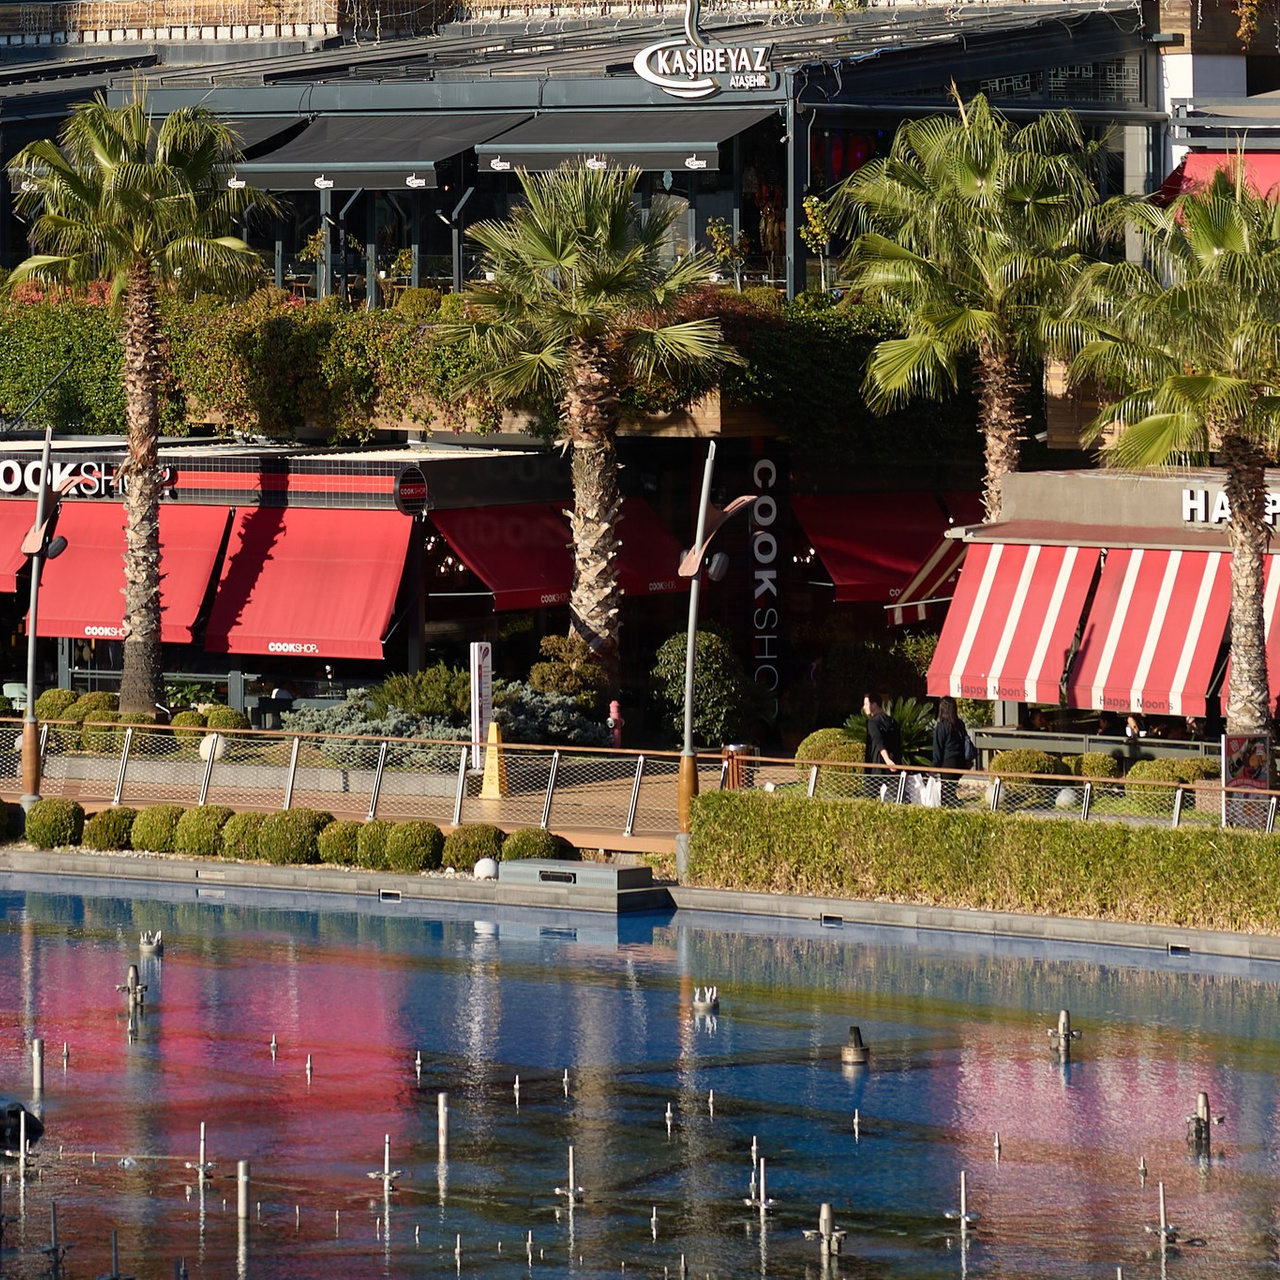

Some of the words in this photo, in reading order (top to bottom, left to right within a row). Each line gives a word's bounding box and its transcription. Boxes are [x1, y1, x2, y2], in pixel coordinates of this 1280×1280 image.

[657, 47, 766, 80] KAŞIBEYAZ
[729, 73, 767, 89] ATAŞEHİR
[957, 683, 987, 698] Happy
[993, 686, 1029, 698] Moon's
[1099, 695, 1131, 709] Happy
[1136, 698, 1174, 711] Moon's
